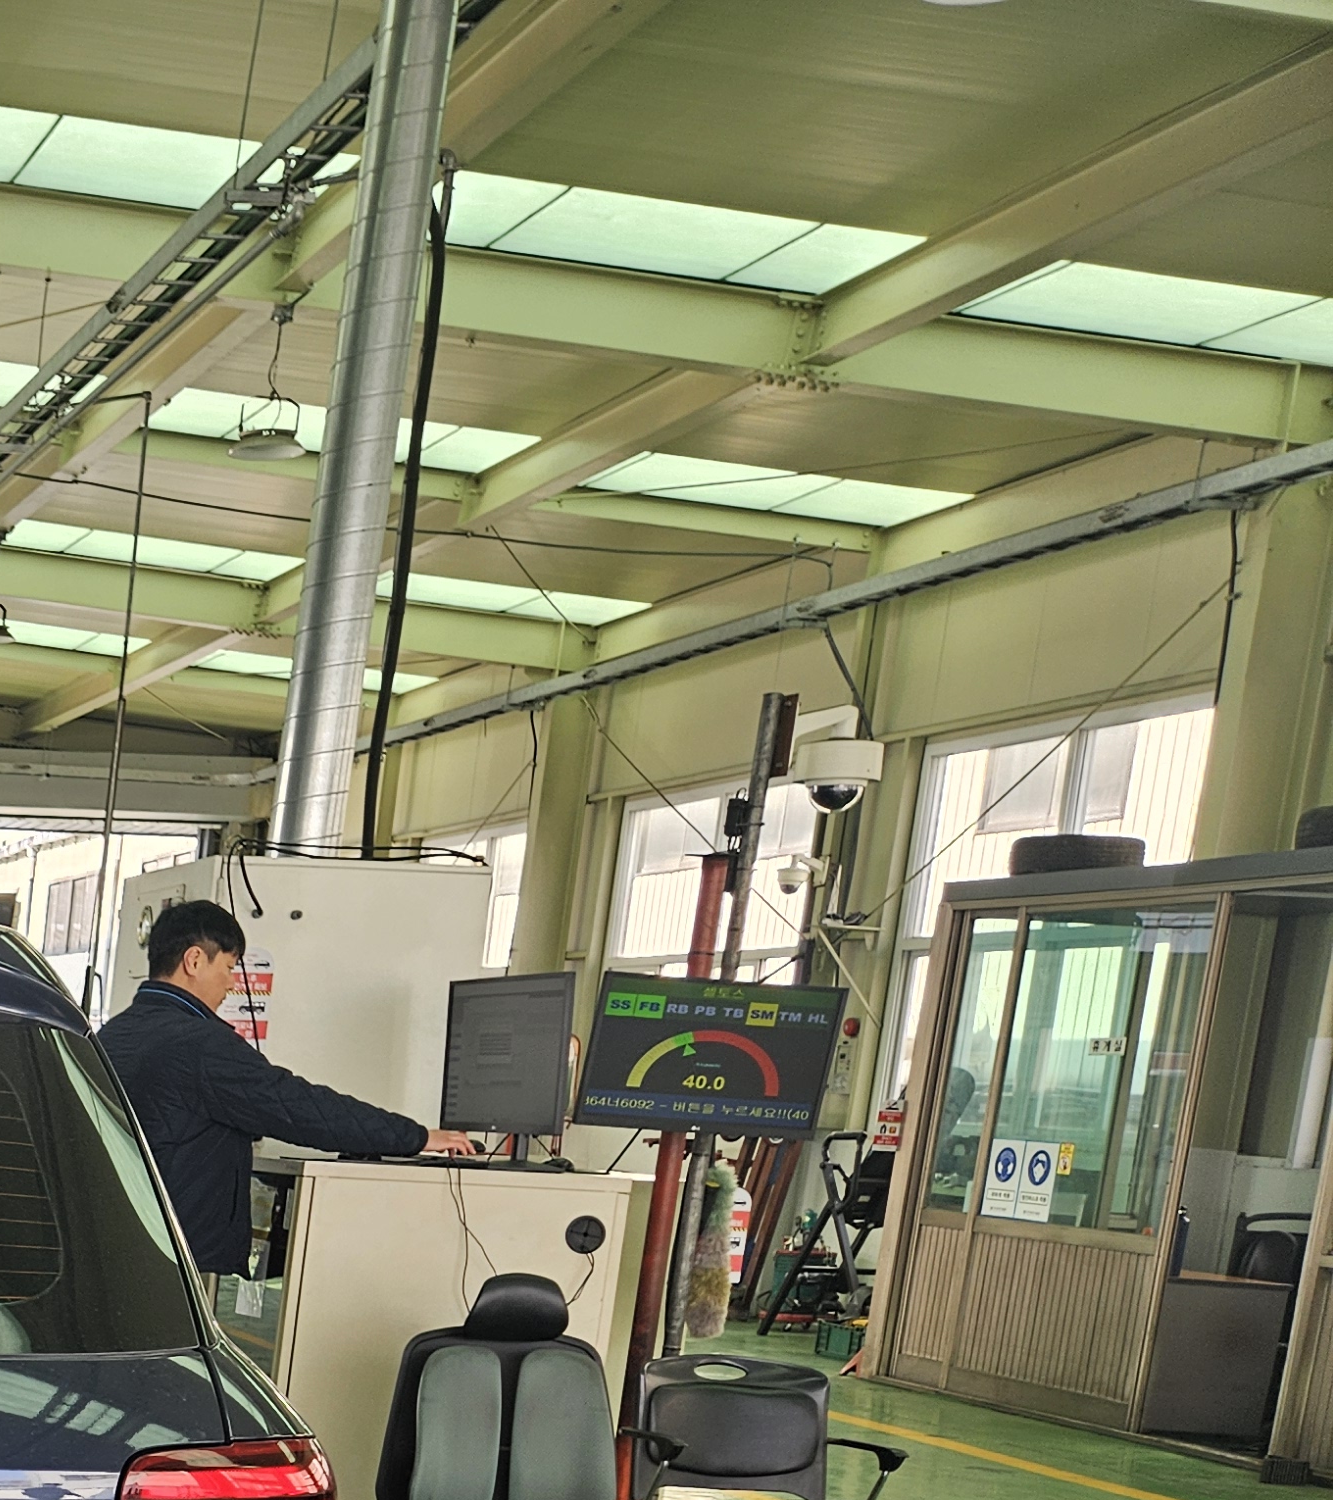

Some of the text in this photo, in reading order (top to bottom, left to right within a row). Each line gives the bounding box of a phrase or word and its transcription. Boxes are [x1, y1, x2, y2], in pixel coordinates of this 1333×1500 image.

[610, 999, 829, 1024] SS FB RB PB TB SM TM HL
[682, 1074, 725, 1091] 40.0
[673, 1101, 715, 1115] 버튼을
